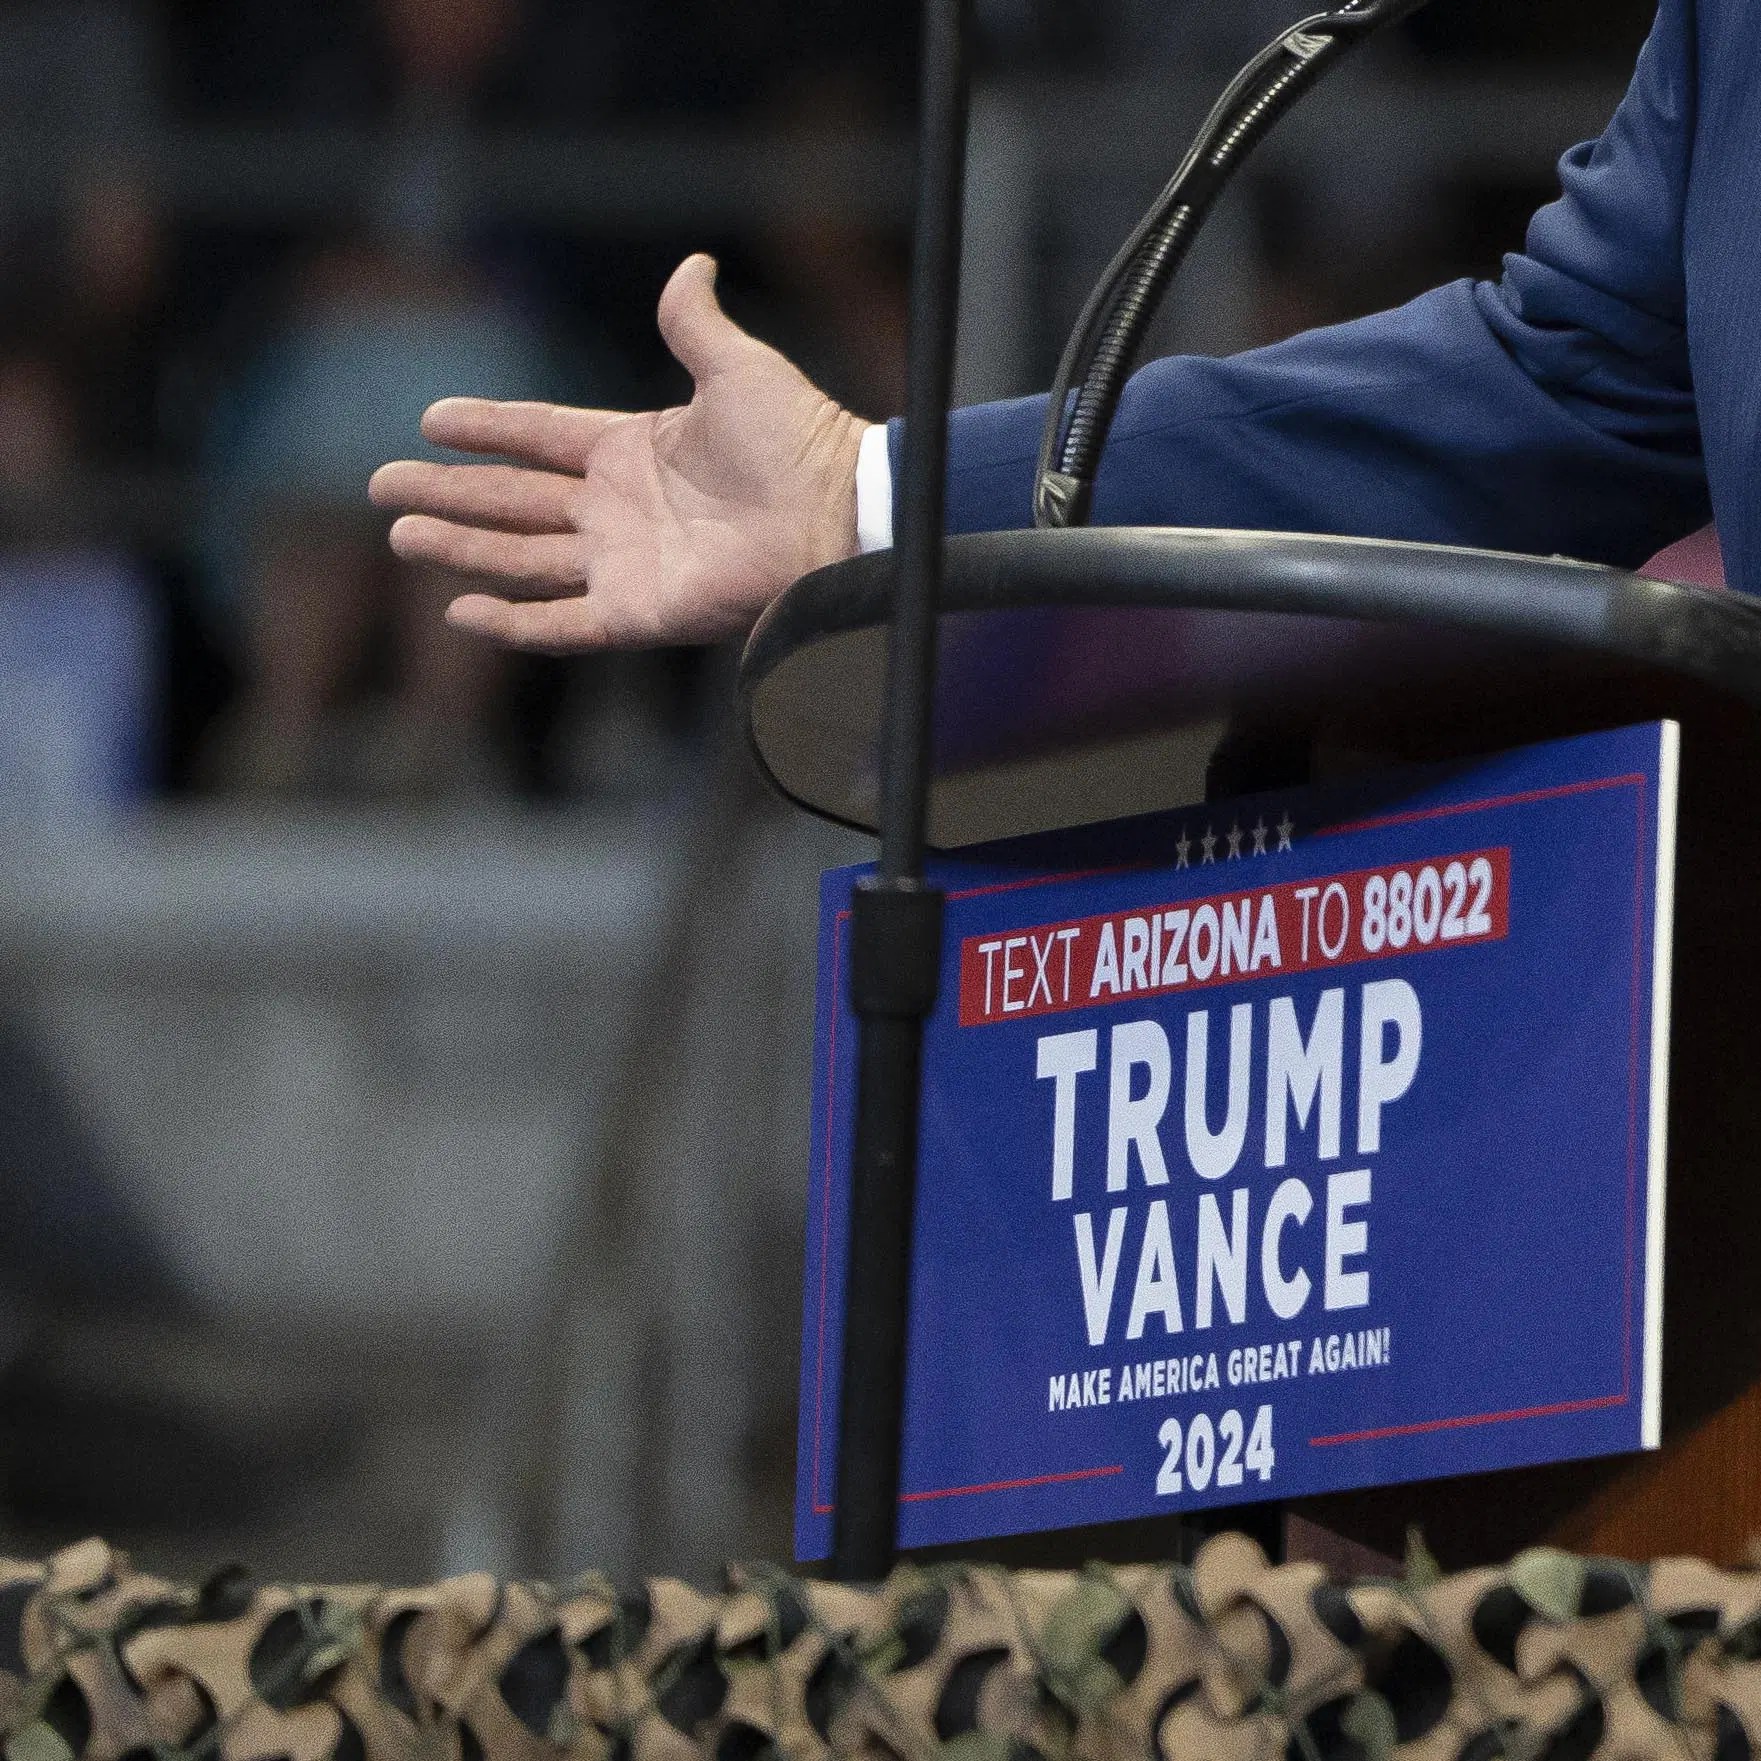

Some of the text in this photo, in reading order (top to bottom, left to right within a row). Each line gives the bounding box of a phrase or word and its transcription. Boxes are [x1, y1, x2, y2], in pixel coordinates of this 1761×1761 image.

[977, 856, 1494, 1016] TEXT ARIZONA TO 88022
[1036, 978, 1423, 1202] TRUMP
[1072, 1168, 1372, 1347] VANCE
[1048, 1327, 1391, 1412] MAKE AMERICA GREAT AGAIN!
[1155, 1404, 1276, 1496] 2024
